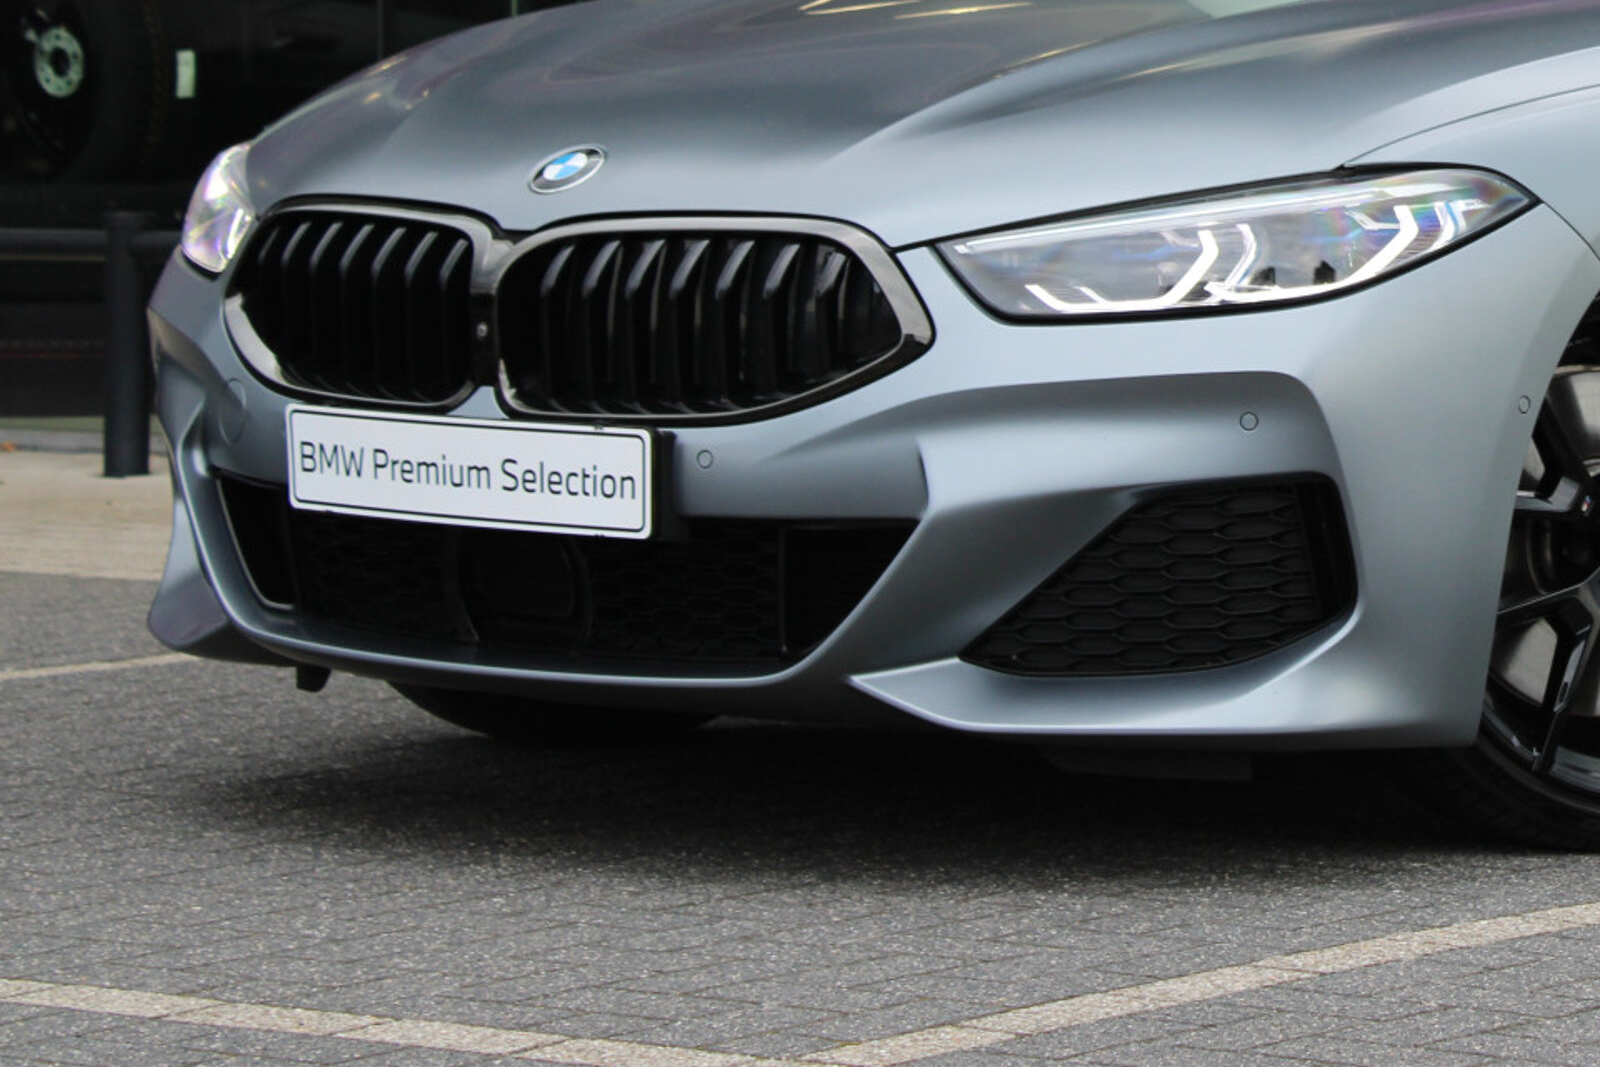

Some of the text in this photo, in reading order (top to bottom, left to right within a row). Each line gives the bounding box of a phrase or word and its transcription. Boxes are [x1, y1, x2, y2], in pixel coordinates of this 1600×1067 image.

[300, 440, 636, 500] BMW Premium Selection
